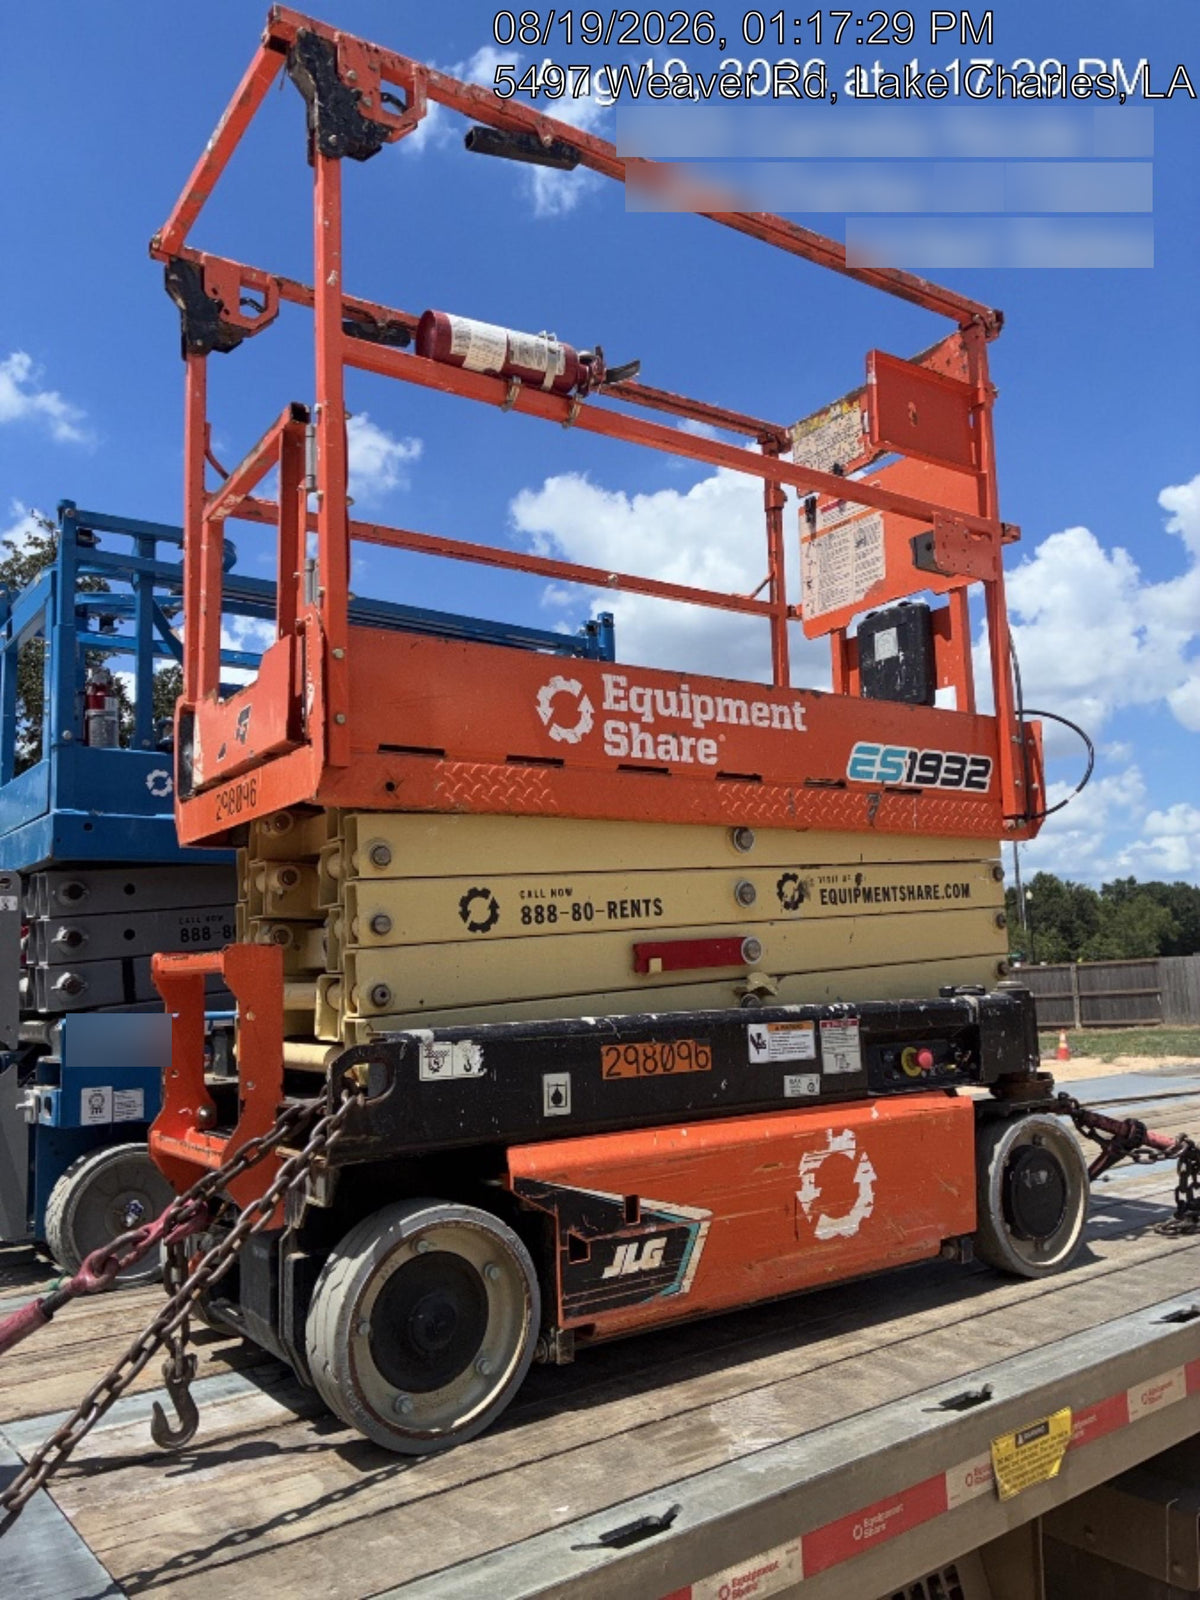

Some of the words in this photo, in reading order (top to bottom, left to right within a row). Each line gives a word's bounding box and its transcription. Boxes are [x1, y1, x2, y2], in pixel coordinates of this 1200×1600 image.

[602, 673, 808, 732] Equipment
[603, 719, 718, 765] Share
[848, 743, 992, 791] ES1932
[519, 888, 546, 899] CALL
[550, 887, 573, 897] NOW
[521, 897, 663, 925] 888-80-RENTS
[819, 883, 971, 906] EQUIPMENTSHARE.COM
[605, 1041, 710, 1077] 298096
[601, 1237, 668, 1279] JLG
